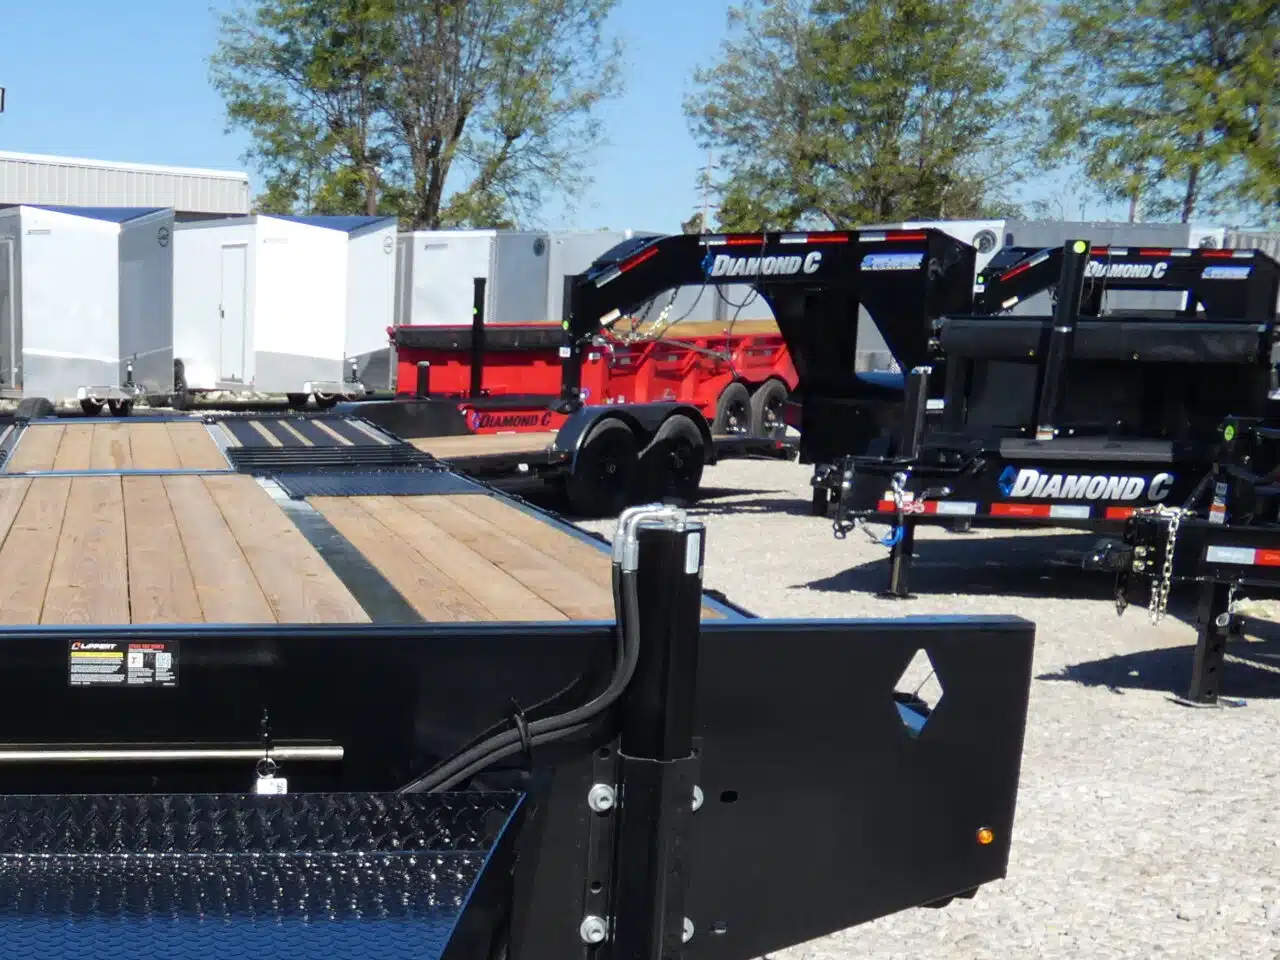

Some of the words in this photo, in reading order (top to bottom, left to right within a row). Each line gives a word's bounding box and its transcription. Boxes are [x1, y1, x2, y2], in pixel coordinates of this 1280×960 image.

[710, 254, 802, 277] DIAMOND
[803, 251, 822, 274] C
[1084, 261, 1153, 279] DIAMOND
[1152, 262, 1168, 279] C
[1010, 469, 1145, 500] DIAMOND
[1147, 473, 1174, 501] C
